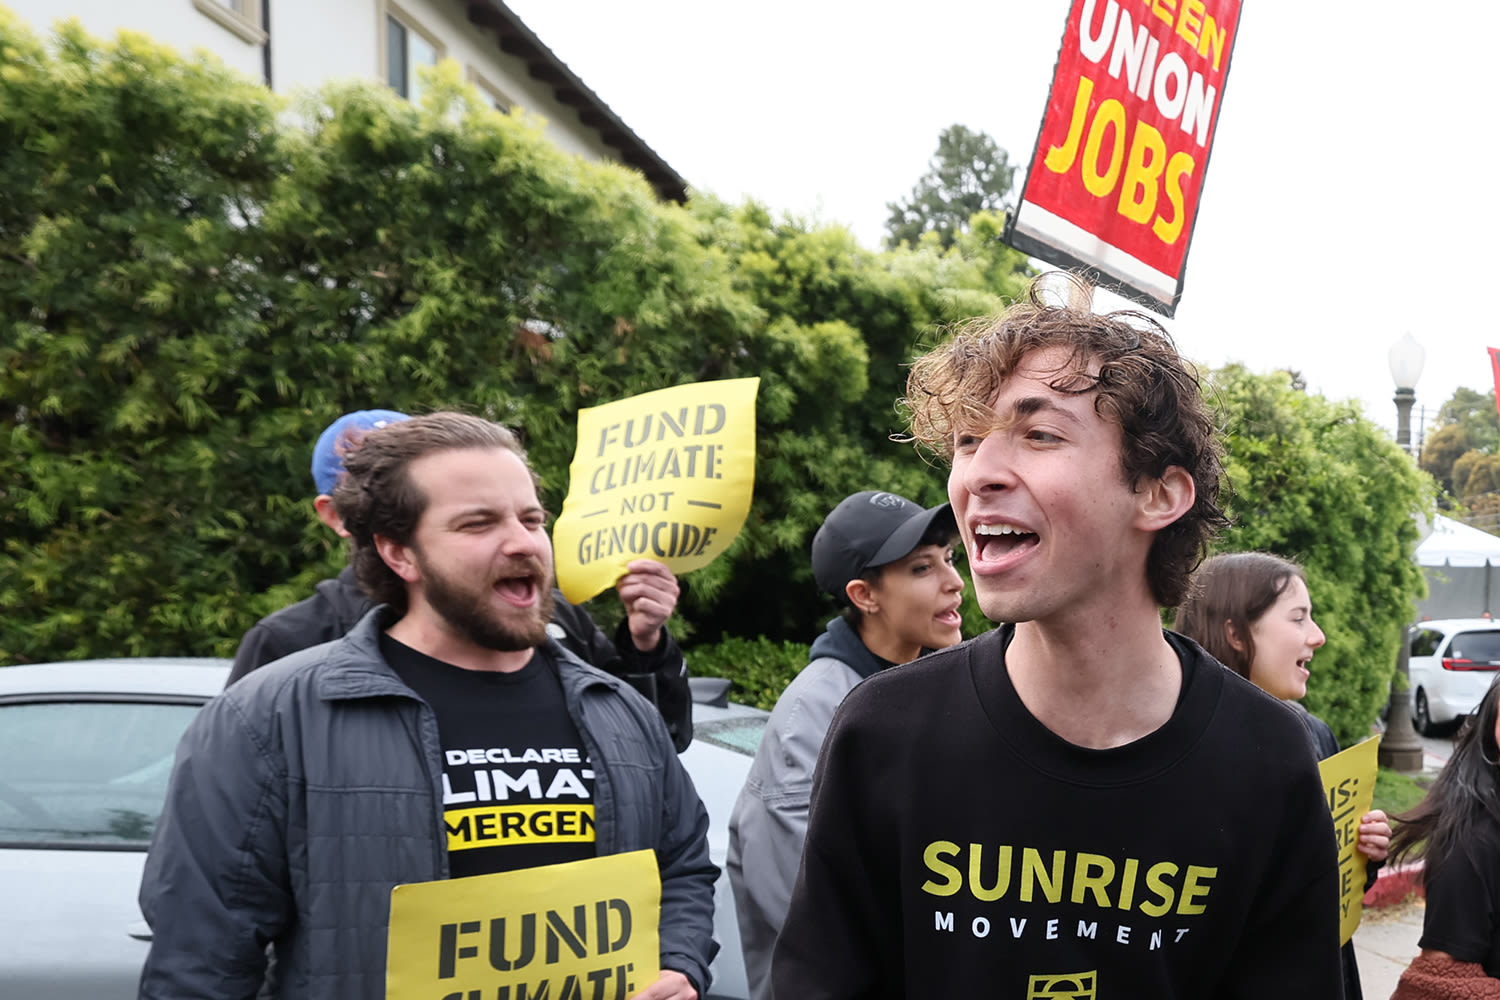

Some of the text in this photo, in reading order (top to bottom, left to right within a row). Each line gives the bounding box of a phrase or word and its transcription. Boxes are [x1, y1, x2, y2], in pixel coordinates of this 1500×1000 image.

[1079, 0, 1216, 147] UNION
[1044, 75, 1195, 244] JOBS
[596, 403, 726, 457] FUND
[590, 444, 724, 495] CLIMATE
[620, 491, 675, 515] NOT
[578, 521, 717, 565] GENOCIDE
[445, 748, 581, 766] DECLARE
[442, 768, 595, 805] LIMA
[443, 811, 596, 842] MERGEN
[921, 840, 1218, 917] SUNRISE
[438, 898, 632, 979] FUND
[935, 911, 1190, 950] MOVEMENT
